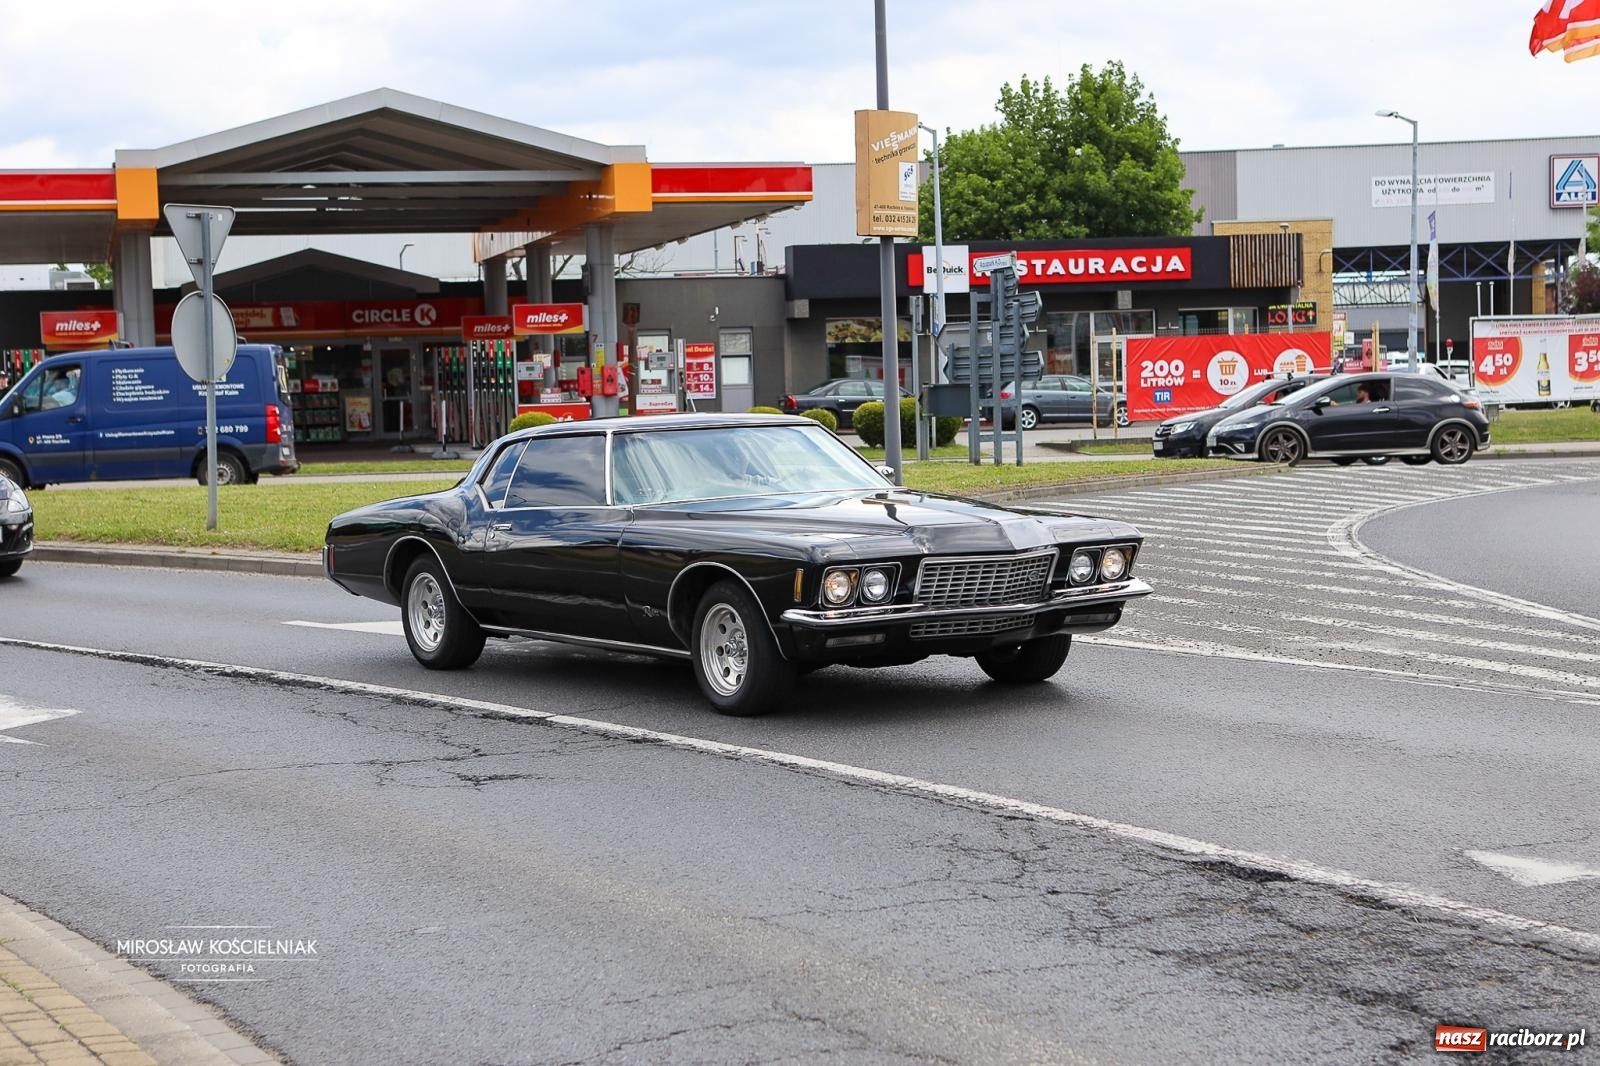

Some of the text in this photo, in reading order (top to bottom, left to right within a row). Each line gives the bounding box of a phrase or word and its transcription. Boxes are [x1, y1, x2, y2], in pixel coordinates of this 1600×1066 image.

[872, 215, 884, 223] tel.
[885, 215, 896, 223] 032
[974, 256, 1185, 277] STAURACJA
[352, 309, 410, 323] CIRCLE
[1141, 360, 1184, 377] 200
[699, 374, 710, 382] 10
[1141, 375, 1184, 387] LITRÓW
[699, 384, 711, 392] 14
[1155, 391, 1170, 401] TIR
[235, 425, 248, 433] 799
